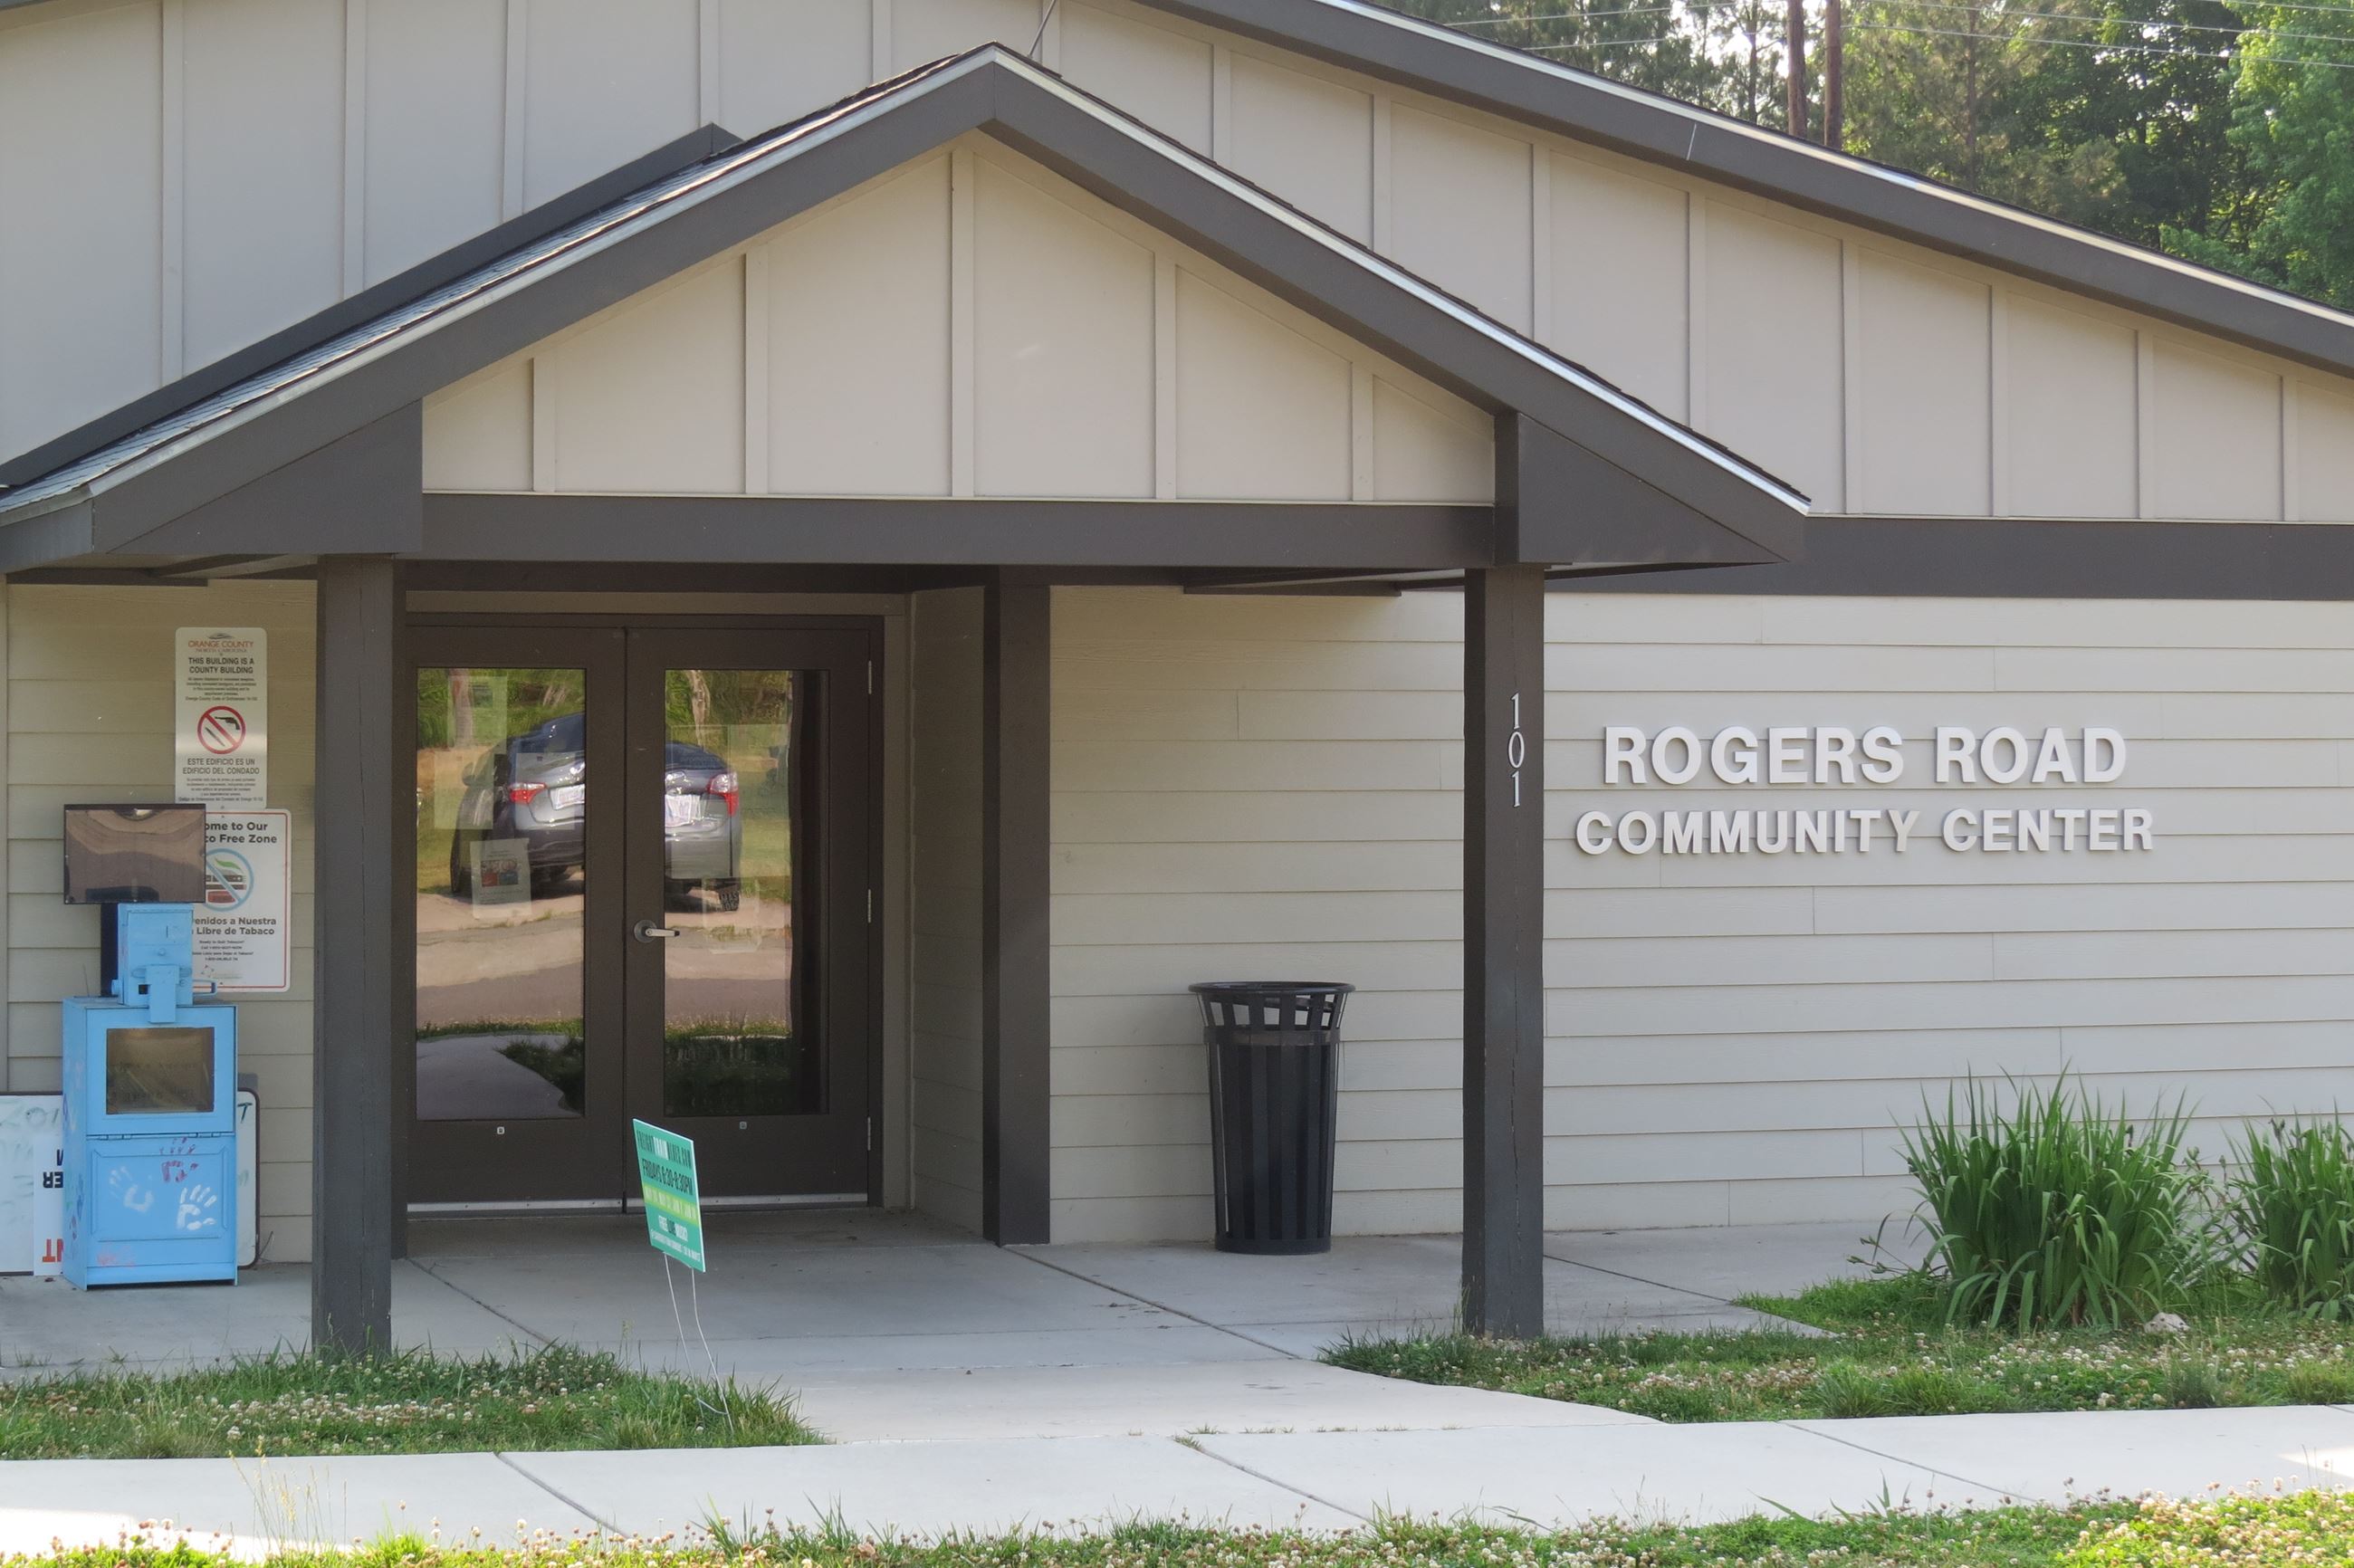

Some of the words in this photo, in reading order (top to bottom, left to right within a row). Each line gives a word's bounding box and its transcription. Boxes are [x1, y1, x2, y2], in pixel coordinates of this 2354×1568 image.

[187, 640, 219, 648] ORANGE
[221, 640, 254, 648] COUNTY
[188, 657, 205, 665] THIS
[206, 657, 239, 665] BUILDING
[241, 657, 248, 665] IS
[249, 657, 255, 665] A
[1507, 693, 1525, 808] 101
[1603, 726, 1904, 784] ROGERS
[1935, 726, 2127, 783] ROAD
[187, 758, 205, 766] ESTE
[206, 758, 234, 766] EDIFICIO
[235, 758, 244, 766] ES
[246, 758, 255, 766] UN
[182, 767, 211, 775] EDIFICIO
[212, 767, 225, 775] DEL
[226, 767, 260, 775] CONDADO
[231, 822, 244, 831] to
[246, 822, 269, 831] Our
[1575, 808, 1919, 856] COMMUNITY
[1942, 808, 2154, 852] CENTER
[219, 834, 245, 844] Free
[248, 834, 278, 844] Zone
[193, 916, 228, 925] enidos
[238, 916, 277, 925] Nuestra
[196, 926, 222, 935] Libre
[224, 926, 237, 935] de
[239, 926, 275, 935] Tabaco
